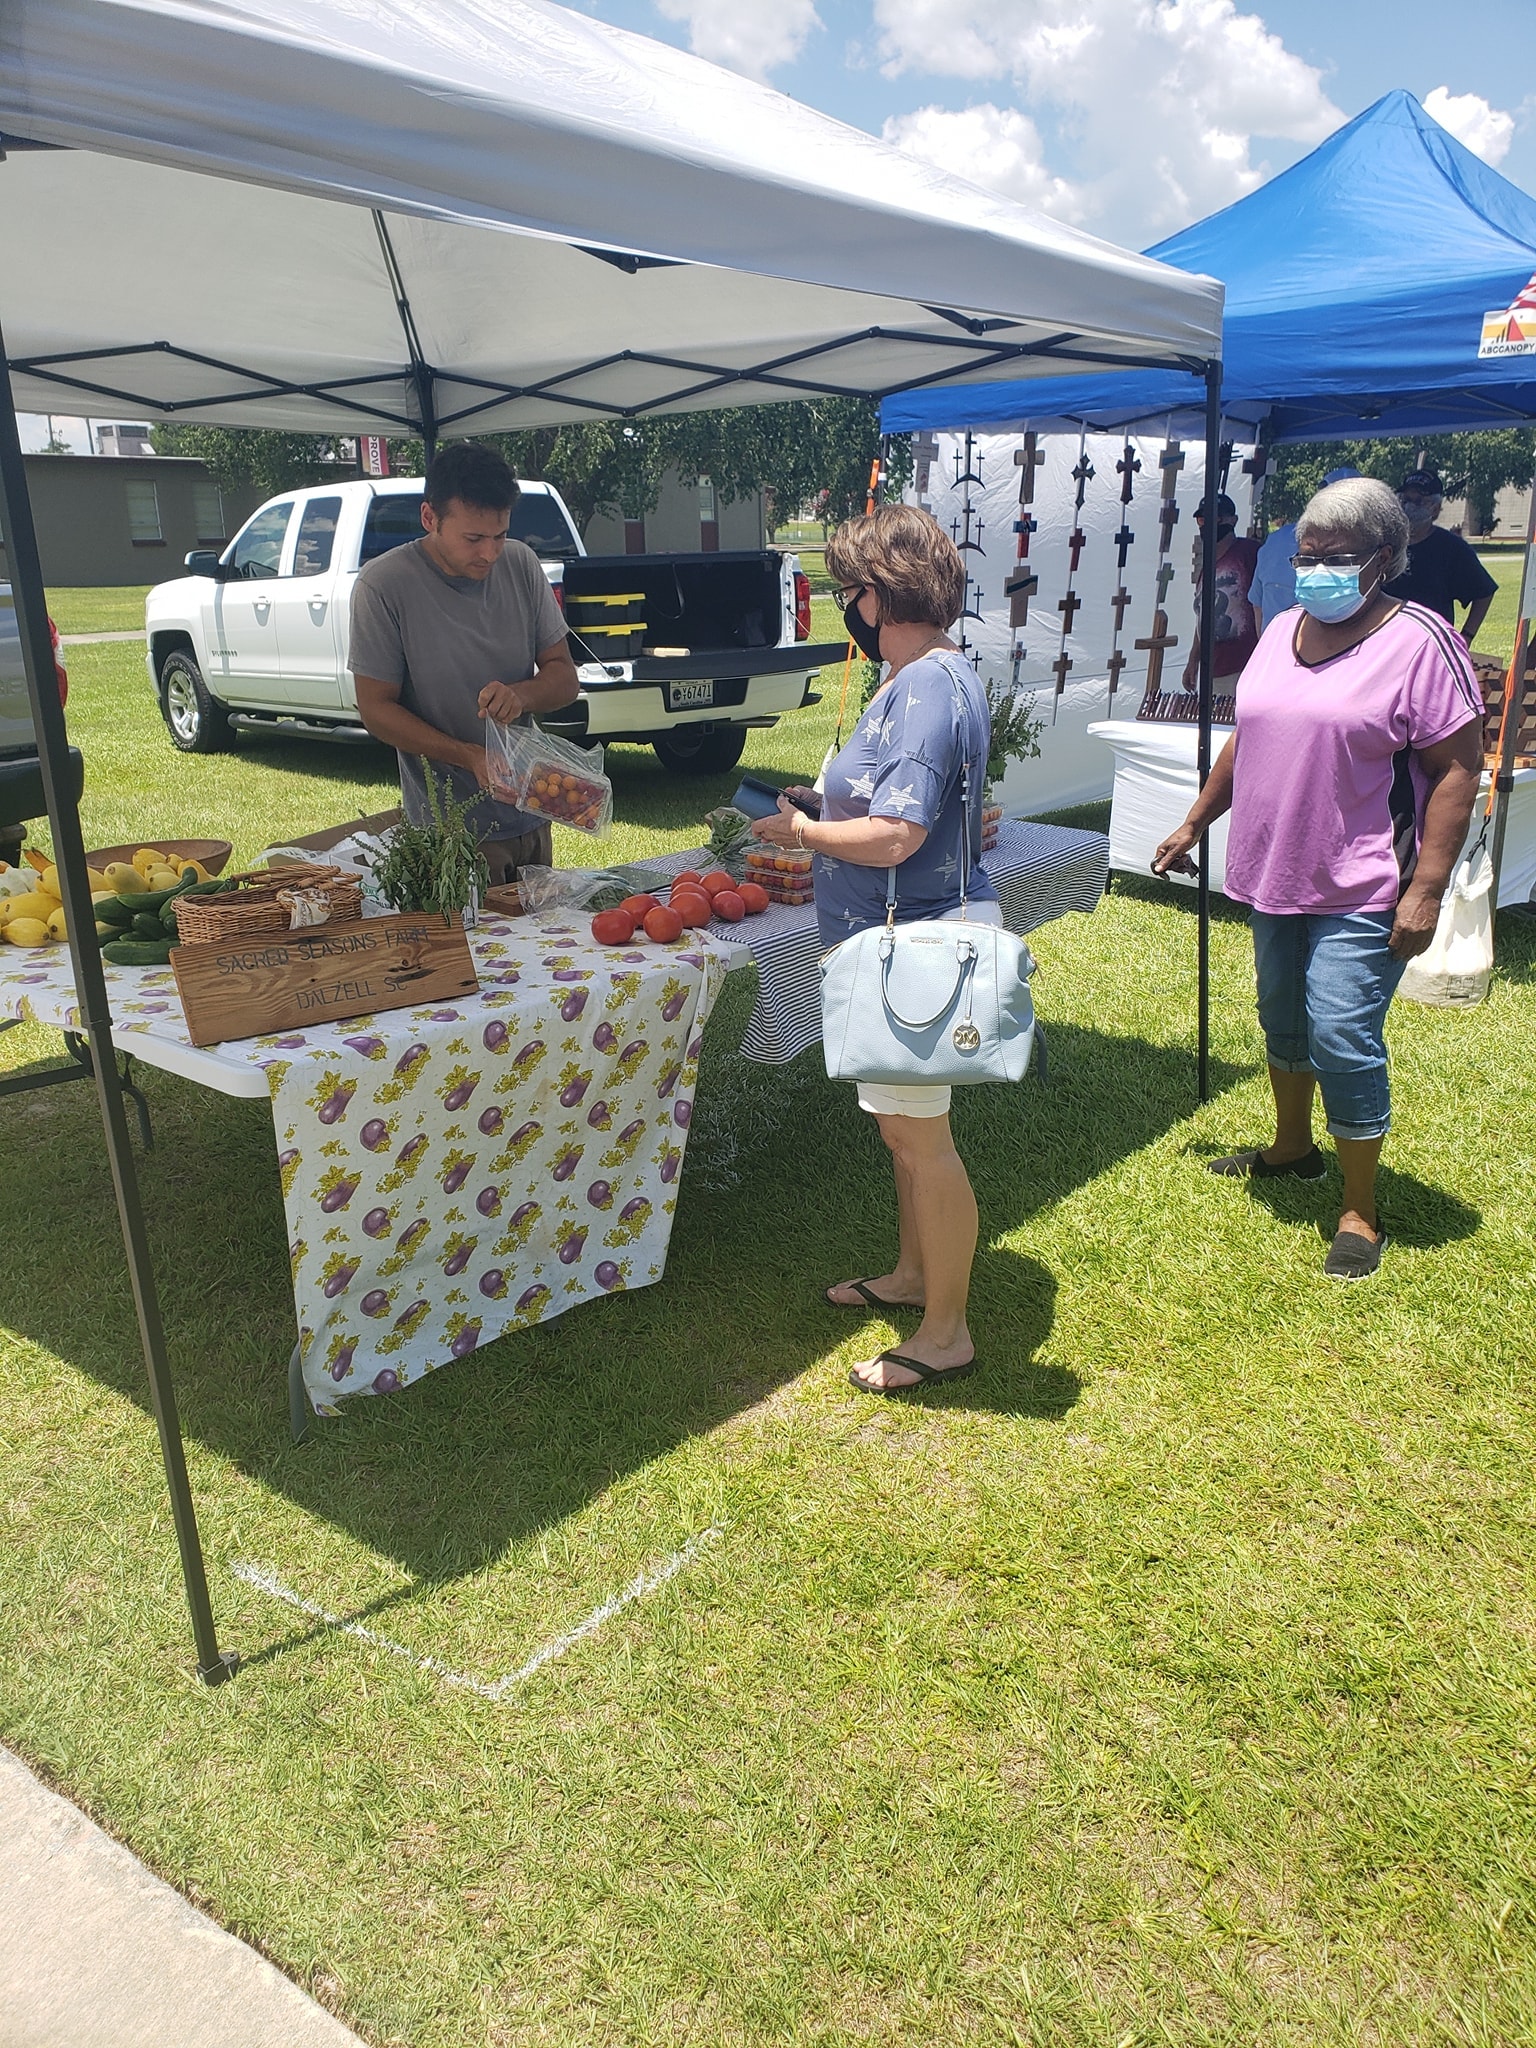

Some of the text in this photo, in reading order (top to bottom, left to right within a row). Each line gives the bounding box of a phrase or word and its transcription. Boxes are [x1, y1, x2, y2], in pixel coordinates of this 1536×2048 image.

[1481, 343, 1535, 354] ABCCANOPY
[687, 684, 711, 699] 67471
[216, 926, 429, 976] SACRED SEASONS FARM
[296, 980, 377, 1010] DALZELL
